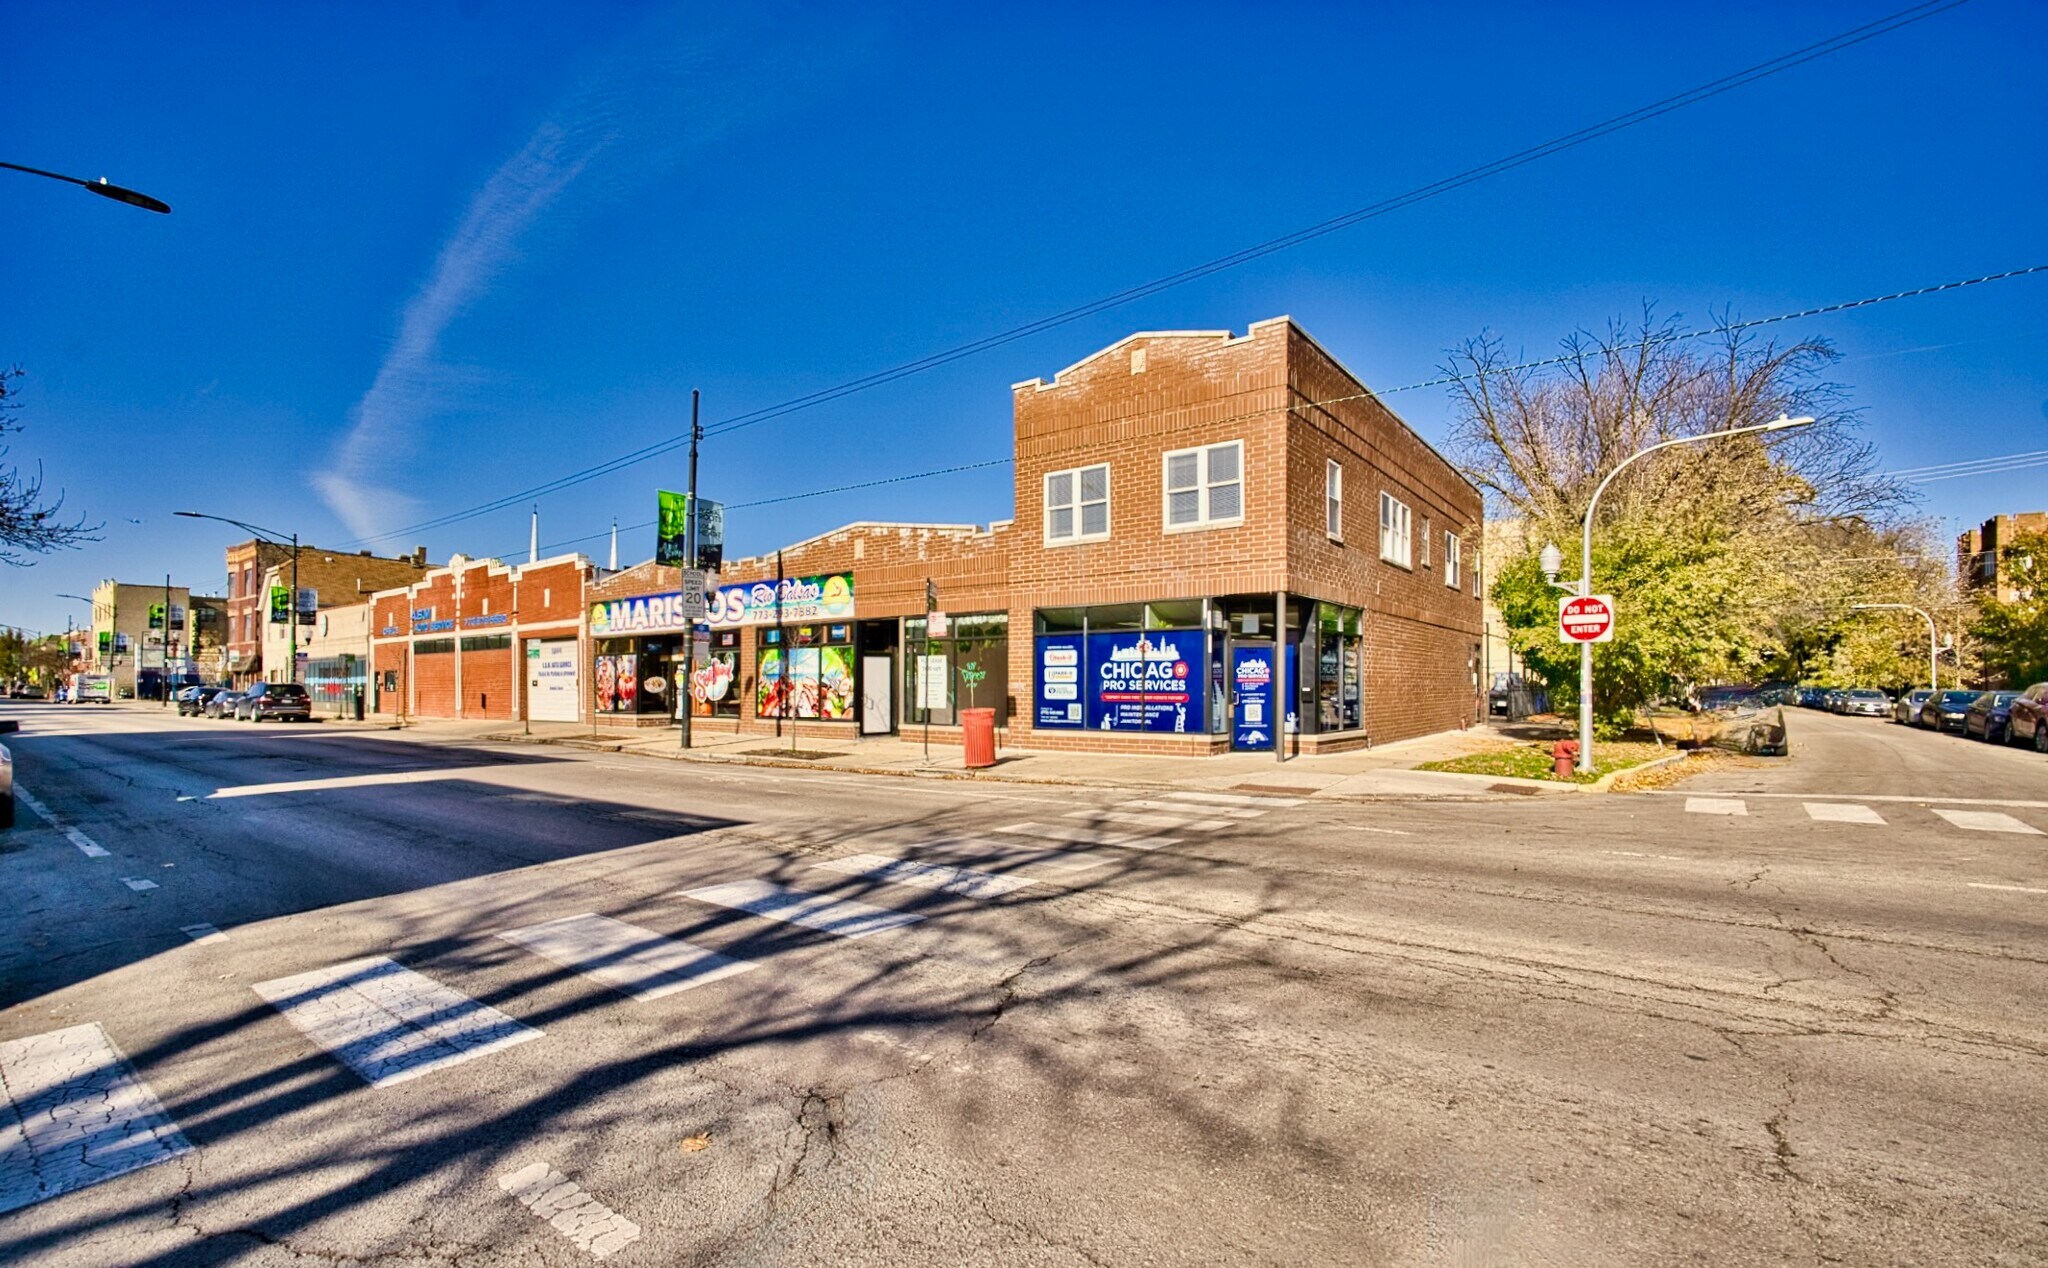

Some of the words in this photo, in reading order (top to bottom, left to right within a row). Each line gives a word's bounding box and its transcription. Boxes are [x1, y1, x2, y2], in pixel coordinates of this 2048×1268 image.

[686, 592, 702, 605] 20
[609, 587, 746, 632] MARISOS
[1567, 605, 1580, 614] DO
[1584, 604, 1604, 614] NOT
[1571, 624, 1601, 634] ENTER
[1103, 681, 1126, 691] PRO
[1129, 680, 1186, 691] SERVICES
